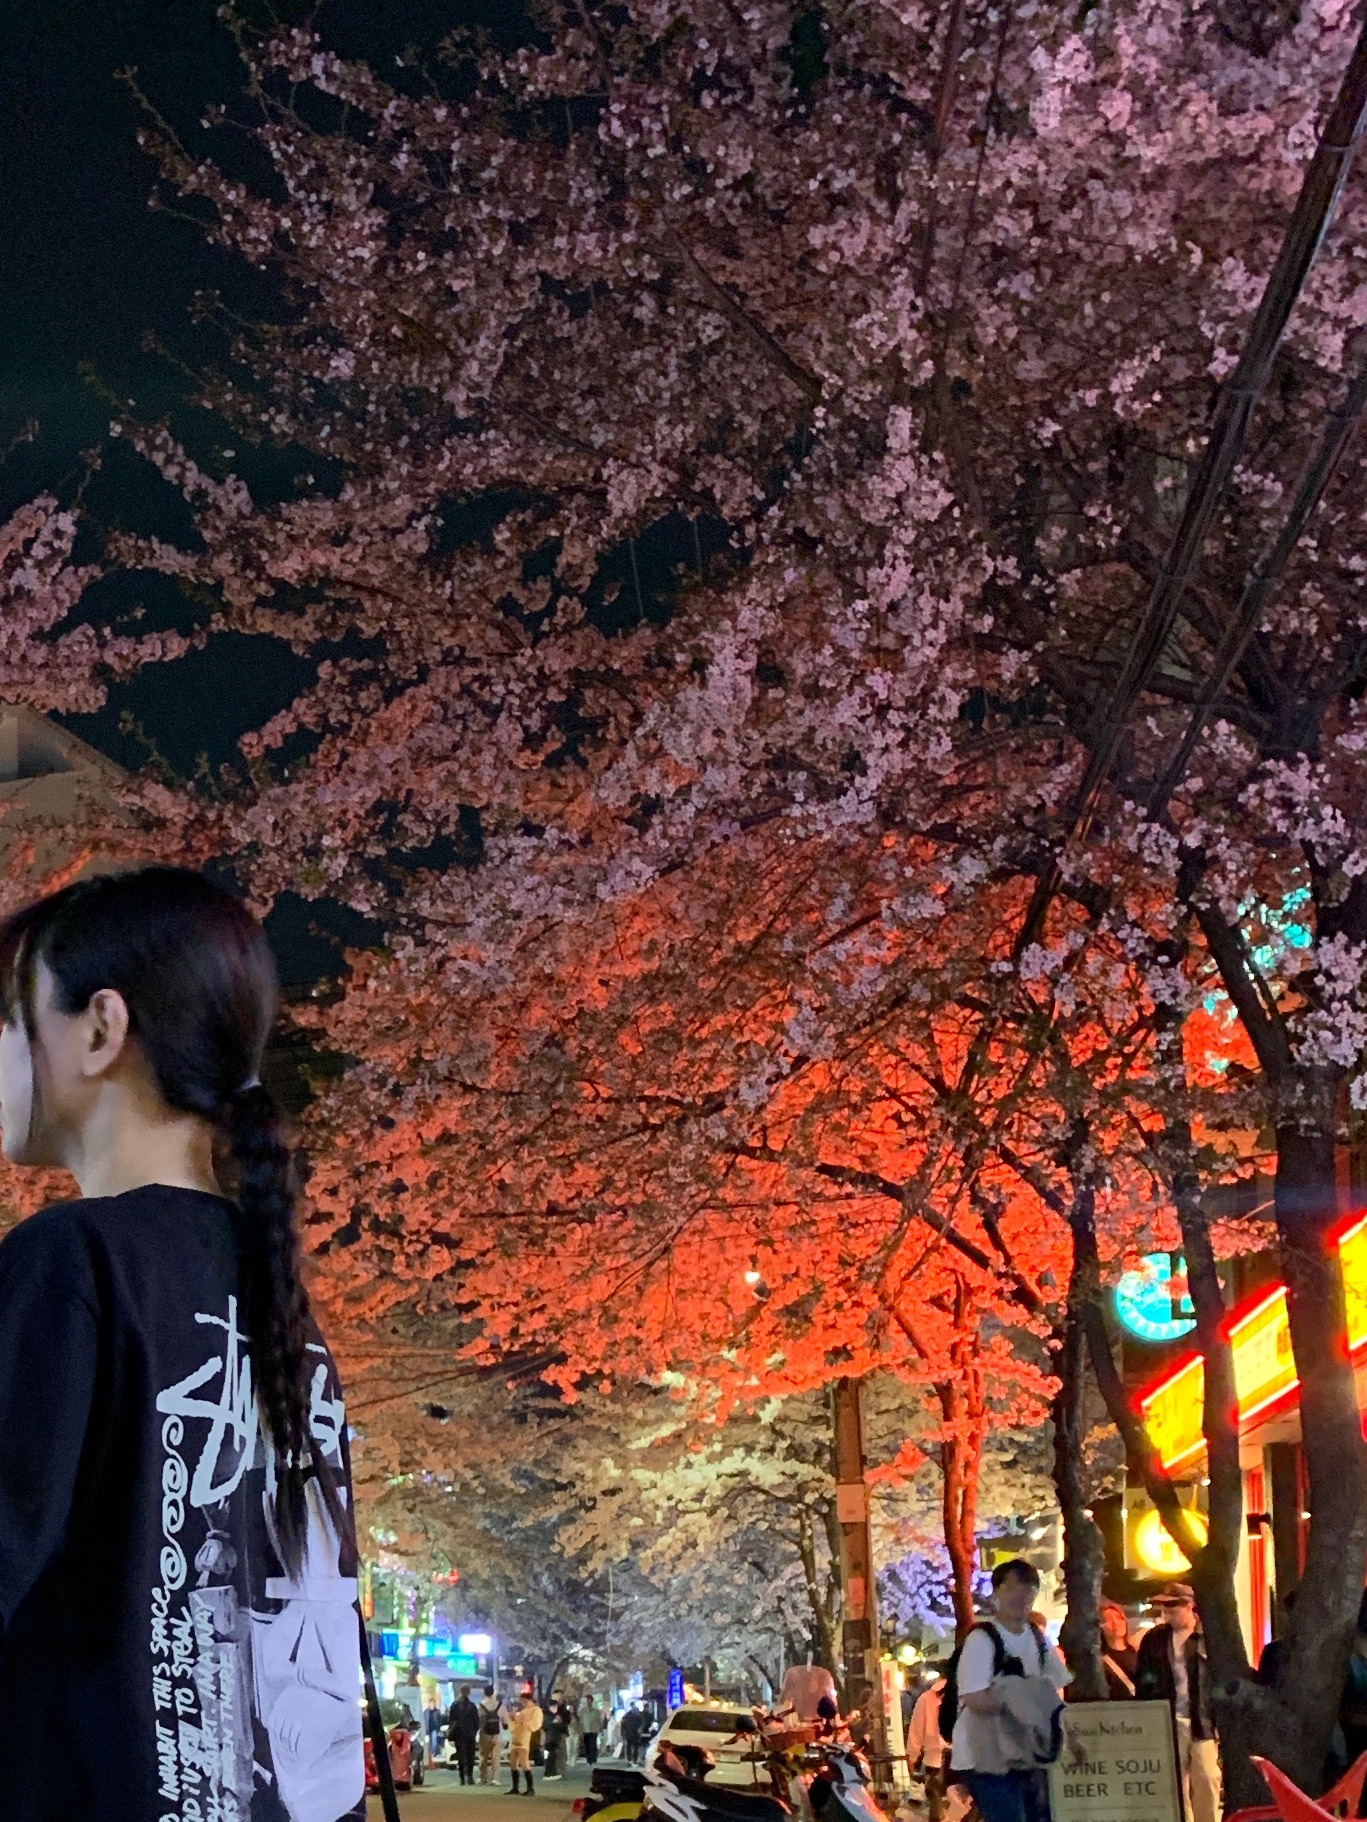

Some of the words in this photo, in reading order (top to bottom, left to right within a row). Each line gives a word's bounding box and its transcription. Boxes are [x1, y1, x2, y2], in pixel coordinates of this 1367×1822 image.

[193, 1592, 216, 1647] WAY
[152, 1661, 173, 1712] THIS
[173, 1687, 199, 1717] TO
[1116, 1758, 1161, 1774] SOJU
[1063, 1782, 1109, 1799] BEER
[1123, 1781, 1157, 1796] ETC
